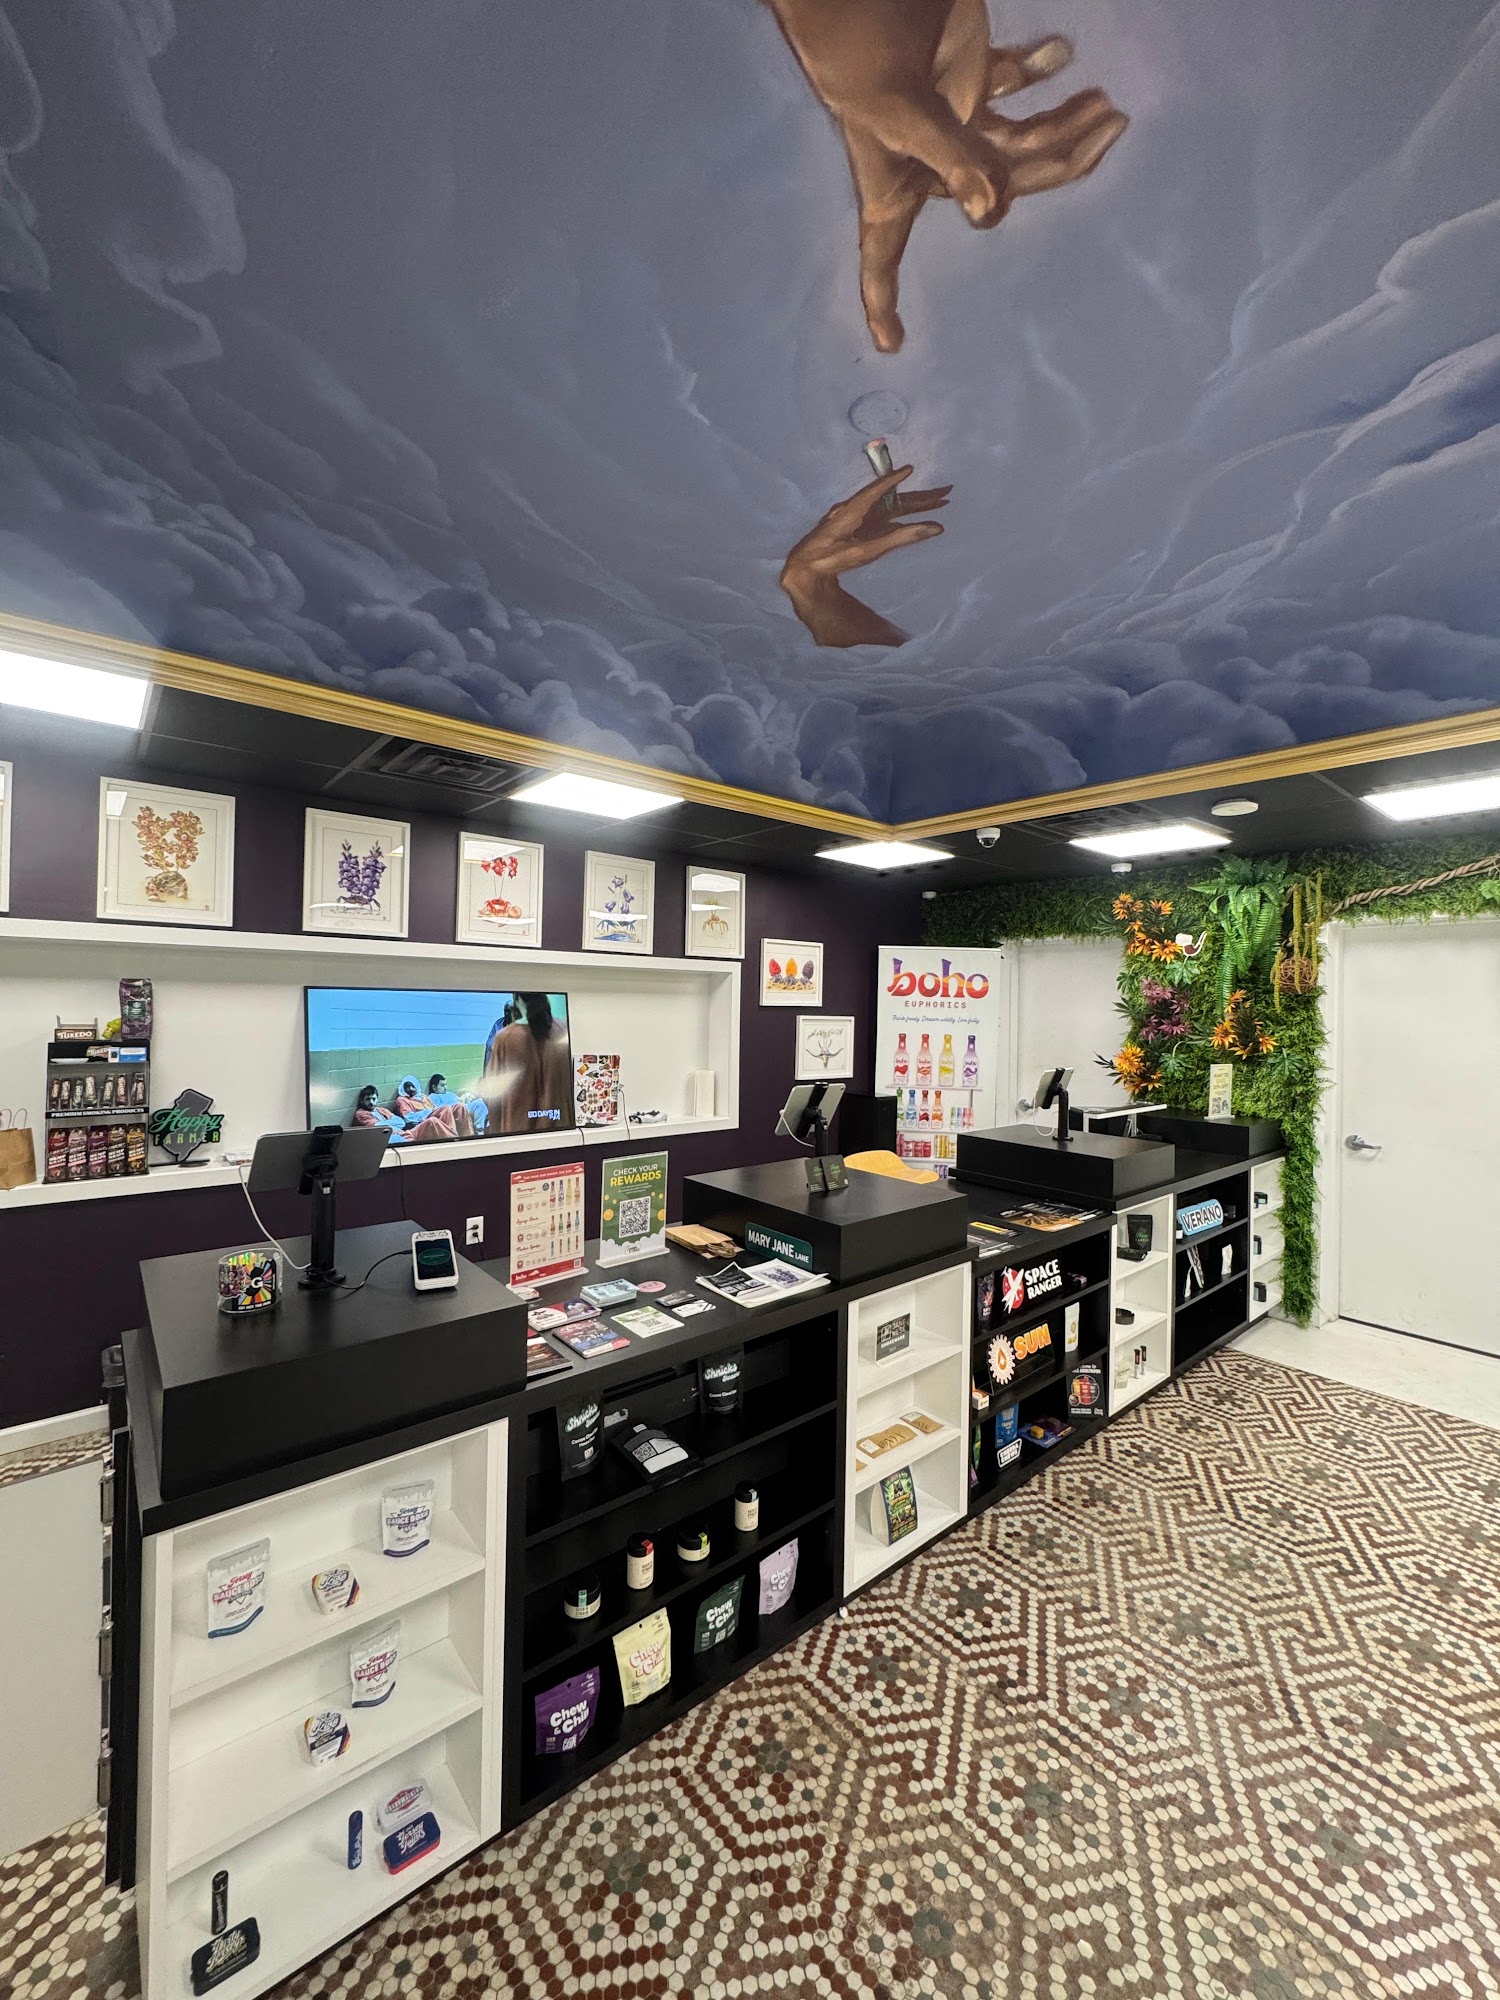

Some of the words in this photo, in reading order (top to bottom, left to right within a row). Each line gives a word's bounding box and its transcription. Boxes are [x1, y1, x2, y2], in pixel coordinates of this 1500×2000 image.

[887, 957, 990, 999] boho
[904, 1000, 968, 1009] EUPHORICS
[57, 1031, 93, 1039] TUXEDO
[149, 1107, 224, 1133] Happy
[538, 1110, 553, 1118] DAYS
[154, 1131, 220, 1145] FARMER
[610, 1170, 662, 1187] REWARDS
[613, 1166, 638, 1176] CHECK
[638, 1164, 658, 1172] YOUR
[1182, 1202, 1222, 1232] VERANO
[748, 1229, 770, 1248] MARY
[772, 1238, 794, 1258] JANE
[794, 1251, 810, 1264] LANE
[251, 1276, 264, 1288] G
[1024, 1258, 1060, 1286] SPACE
[1026, 1274, 1062, 1300] RANGER
[1014, 1322, 1052, 1360] SUN
[704, 1363, 738, 1380] Shnicks
[565, 1403, 598, 1432] Shnicks
[386, 1516, 410, 1525] SAUCE
[228, 1571, 254, 1588] Jersey
[213, 1585, 242, 1601] SAUCE
[706, 1598, 732, 1622] Chew
[630, 1642, 662, 1669] Chew
[355, 1664, 379, 1678] SAUCE
[550, 1700, 587, 1728] Chew
[562, 1707, 589, 1734] Chill
[396, 1821, 424, 1842] Jersey
